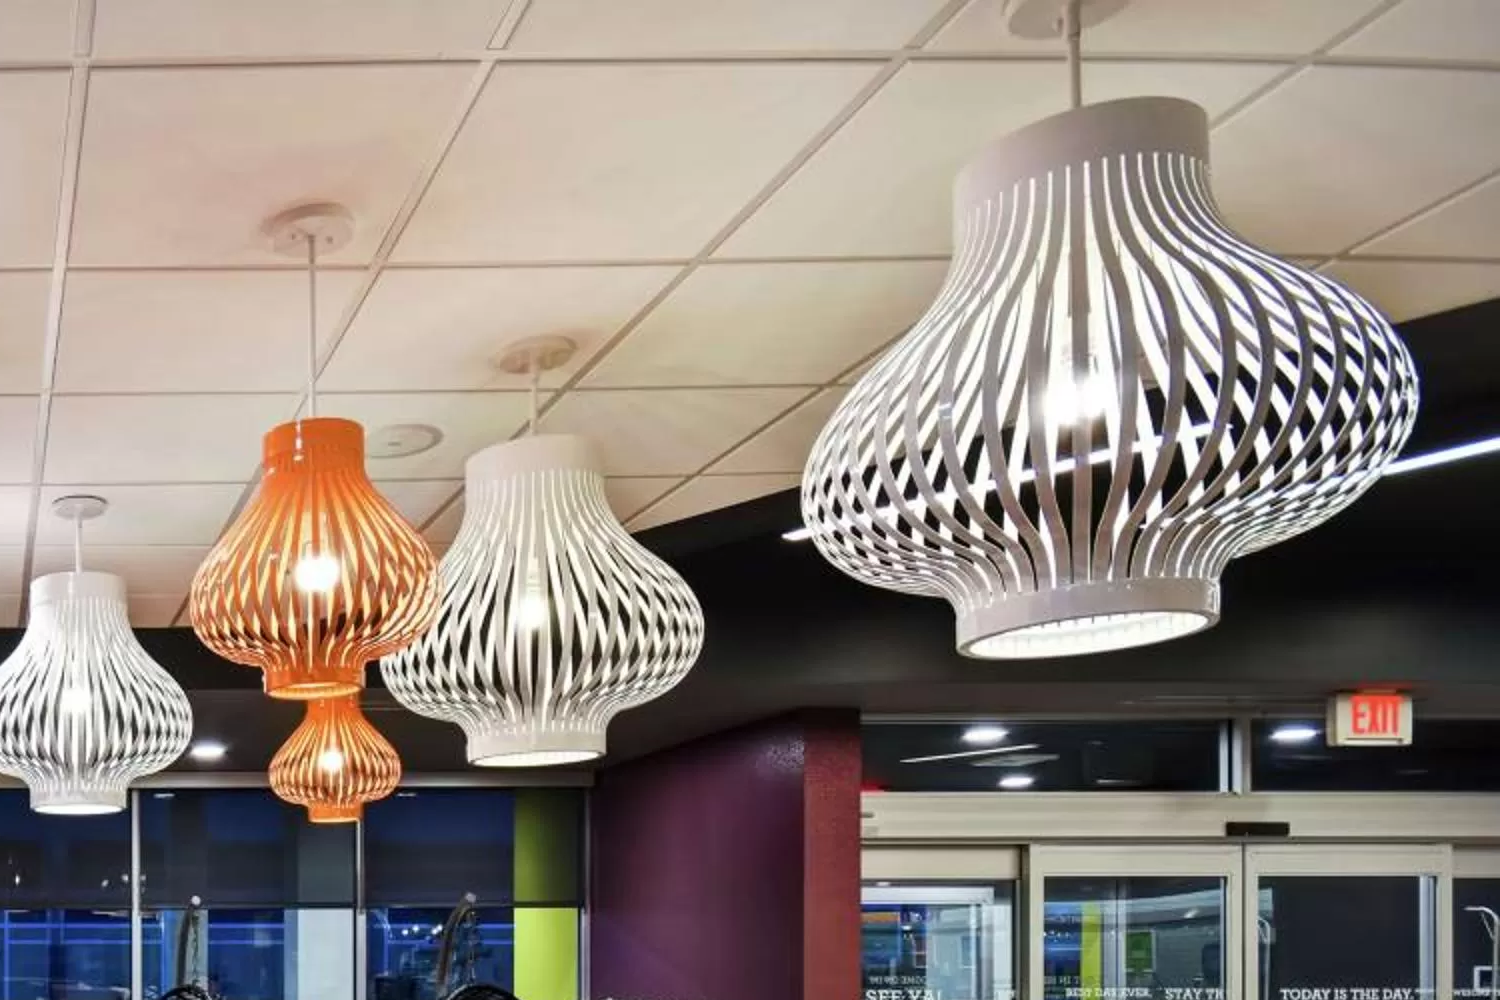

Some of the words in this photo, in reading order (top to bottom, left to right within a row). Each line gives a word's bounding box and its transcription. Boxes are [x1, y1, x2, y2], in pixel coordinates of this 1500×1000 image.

[1350, 695, 1403, 735] EXIT
[1165, 987, 1203, 1000] STAY
[1280, 988, 1330, 1000] TODAY
[1333, 988, 1347, 1000] IS
[1350, 988, 1380, 1000] THE
[1382, 988, 1414, 1000] DAY.
